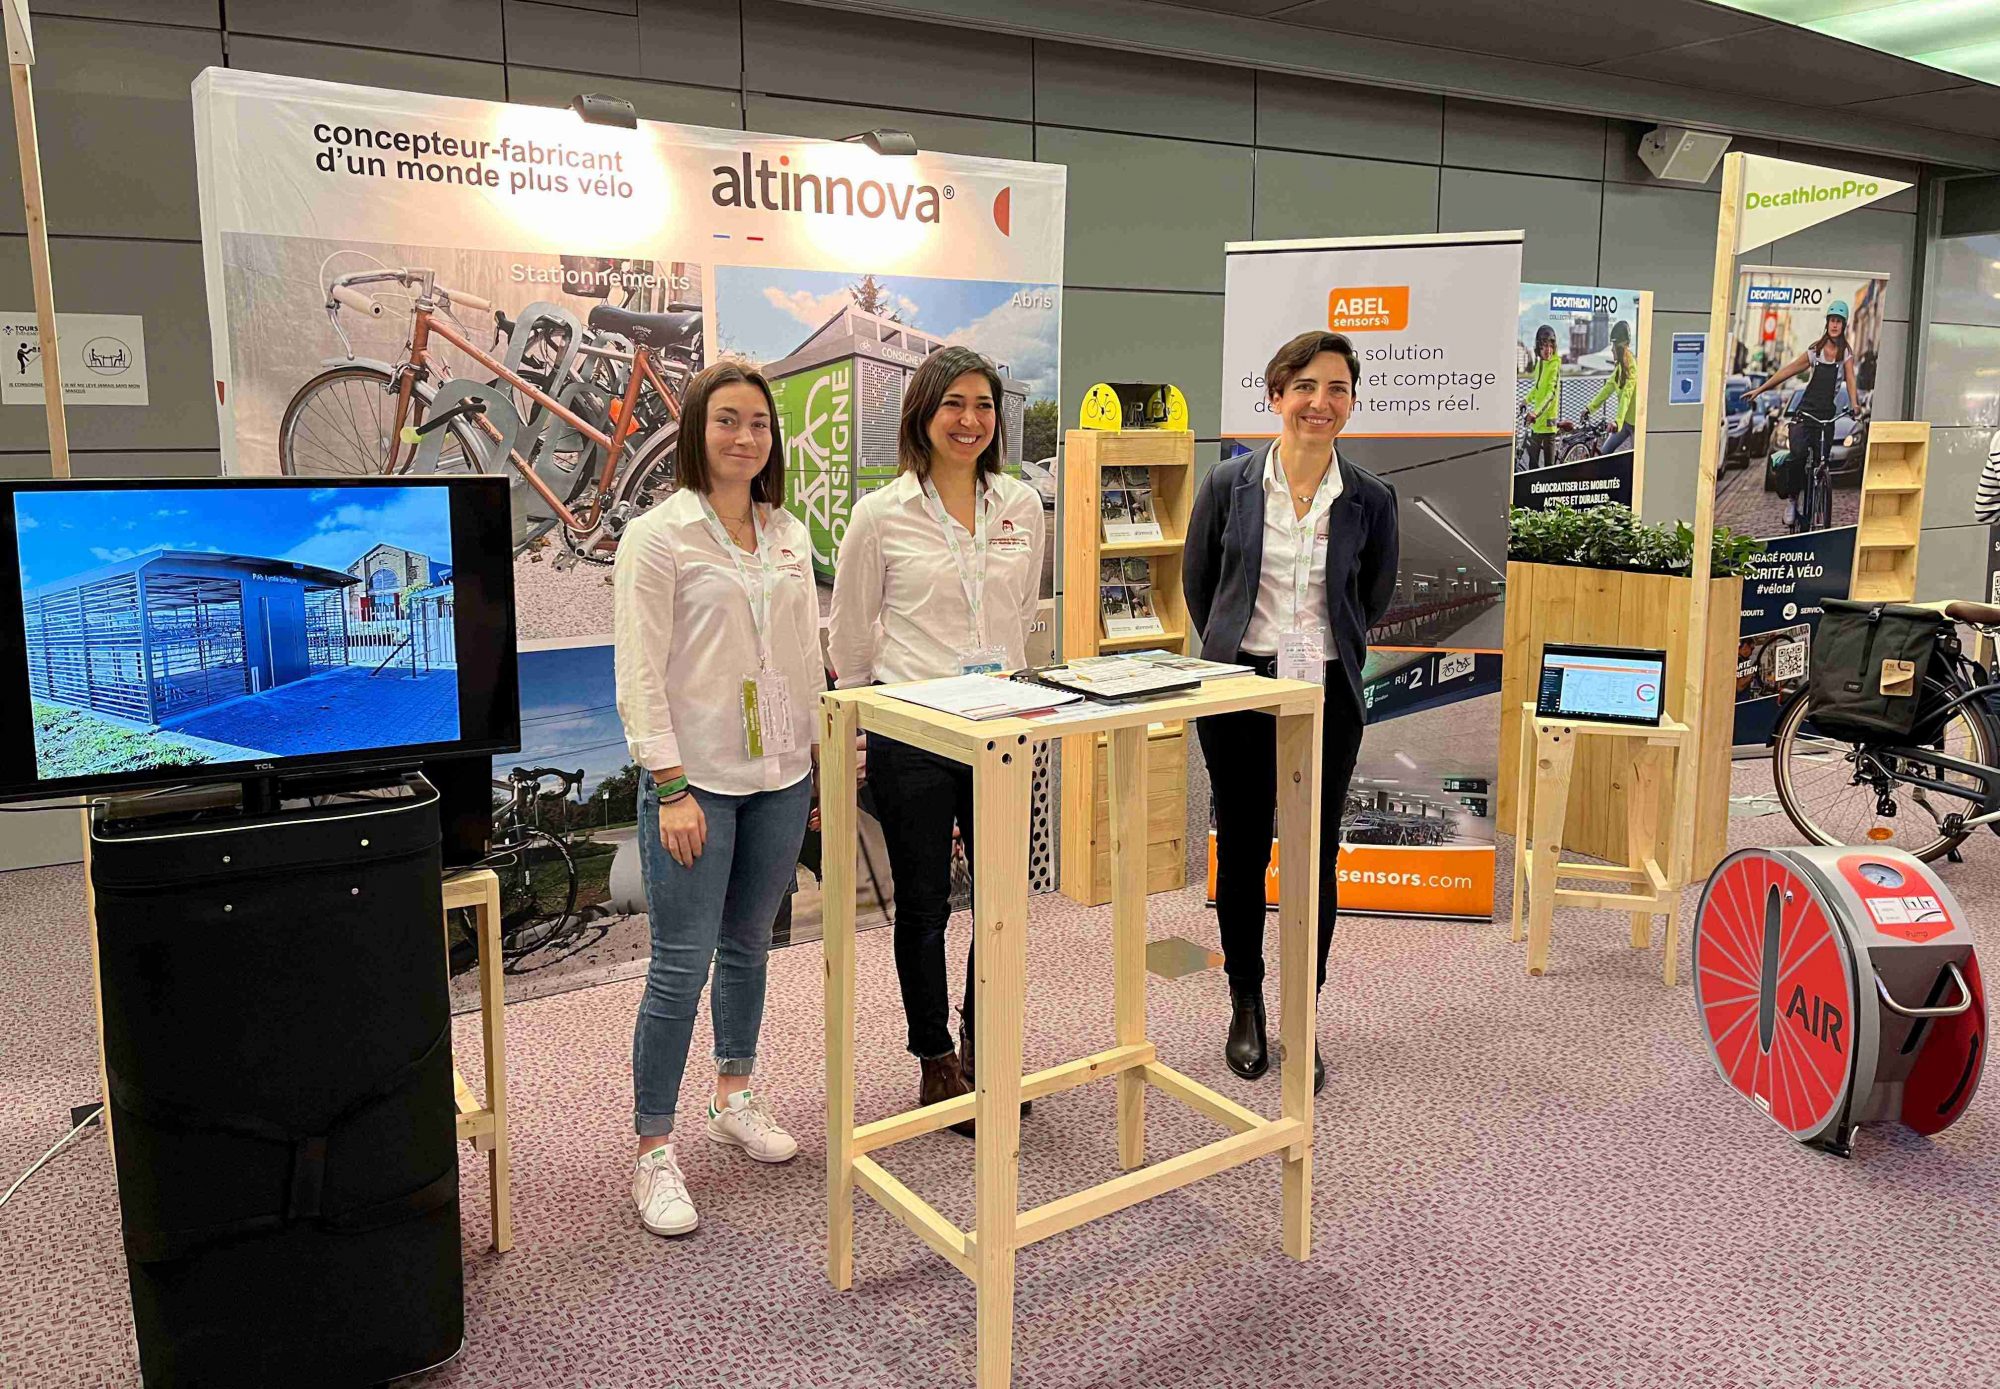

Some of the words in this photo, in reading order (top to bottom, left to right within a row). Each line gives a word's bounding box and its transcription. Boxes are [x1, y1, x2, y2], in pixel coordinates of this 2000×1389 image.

[313, 123, 624, 172] concepteur-fabricant
[397, 160, 500, 187] monde
[510, 167, 569, 194] plus
[578, 173, 633, 198] vélo
[1745, 181, 1878, 209] DecathlonPro
[510, 264, 690, 290] Stationnements
[1011, 293, 1053, 308] Abris
[1552, 296, 1591, 309] DECATHLON
[1594, 295, 1618, 313] PRO
[1750, 290, 1791, 301] DECATHLON
[1793, 288, 1823, 304] PRO
[1334, 298, 1389, 316] ABEL
[1334, 317, 1381, 327] sensors
[881, 347, 919, 366] CONSIGNE
[1365, 343, 1444, 361] solution
[1369, 372, 1388, 386] et
[1393, 371, 1496, 390] comptage
[1370, 398, 1431, 415] temps
[1437, 394, 1480, 412] réel.
[1531, 482, 1578, 494] DÉMOCRATISER
[1579, 480, 1590, 491] LES
[1591, 477, 1621, 490] MOBILITÉS
[1571, 494, 1579, 505] ET
[1748, 551, 1778, 563] NGAGÉ
[1780, 552, 1803, 562] POUR
[1804, 551, 1815, 561] LA
[1786, 565, 1795, 579] À
[1797, 563, 1824, 578] VÉLO
[1756, 582, 1796, 595] #vélotaf
[1394, 672, 1408, 686] Rij
[1408, 667, 1423, 690] 2
[254, 763, 275, 771] TCL
[1338, 868, 1472, 889] sensors.com
[1785, 984, 1843, 1054] AIR
